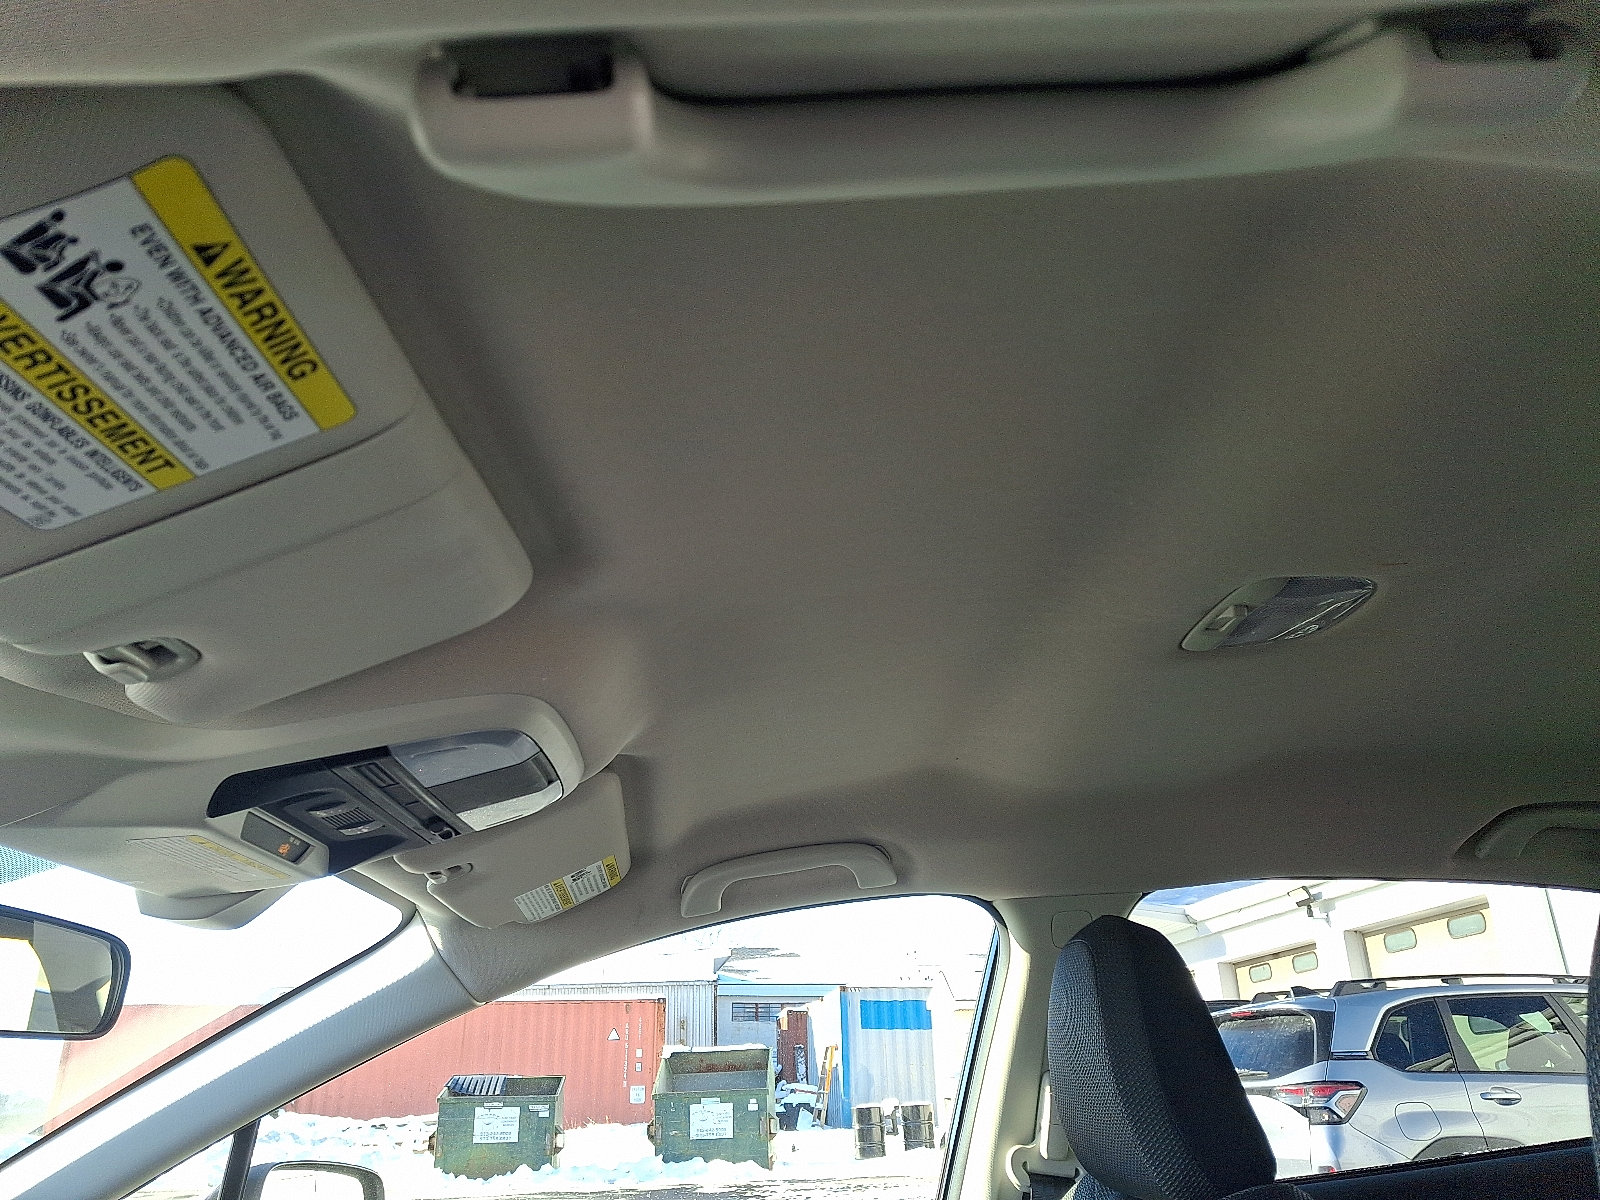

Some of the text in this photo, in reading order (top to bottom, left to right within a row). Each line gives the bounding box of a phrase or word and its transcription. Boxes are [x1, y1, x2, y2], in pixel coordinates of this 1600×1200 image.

[131, 222, 301, 422] EVEN WITH ADVANCED AIR BAGS
[213, 258, 319, 382] WARNING
